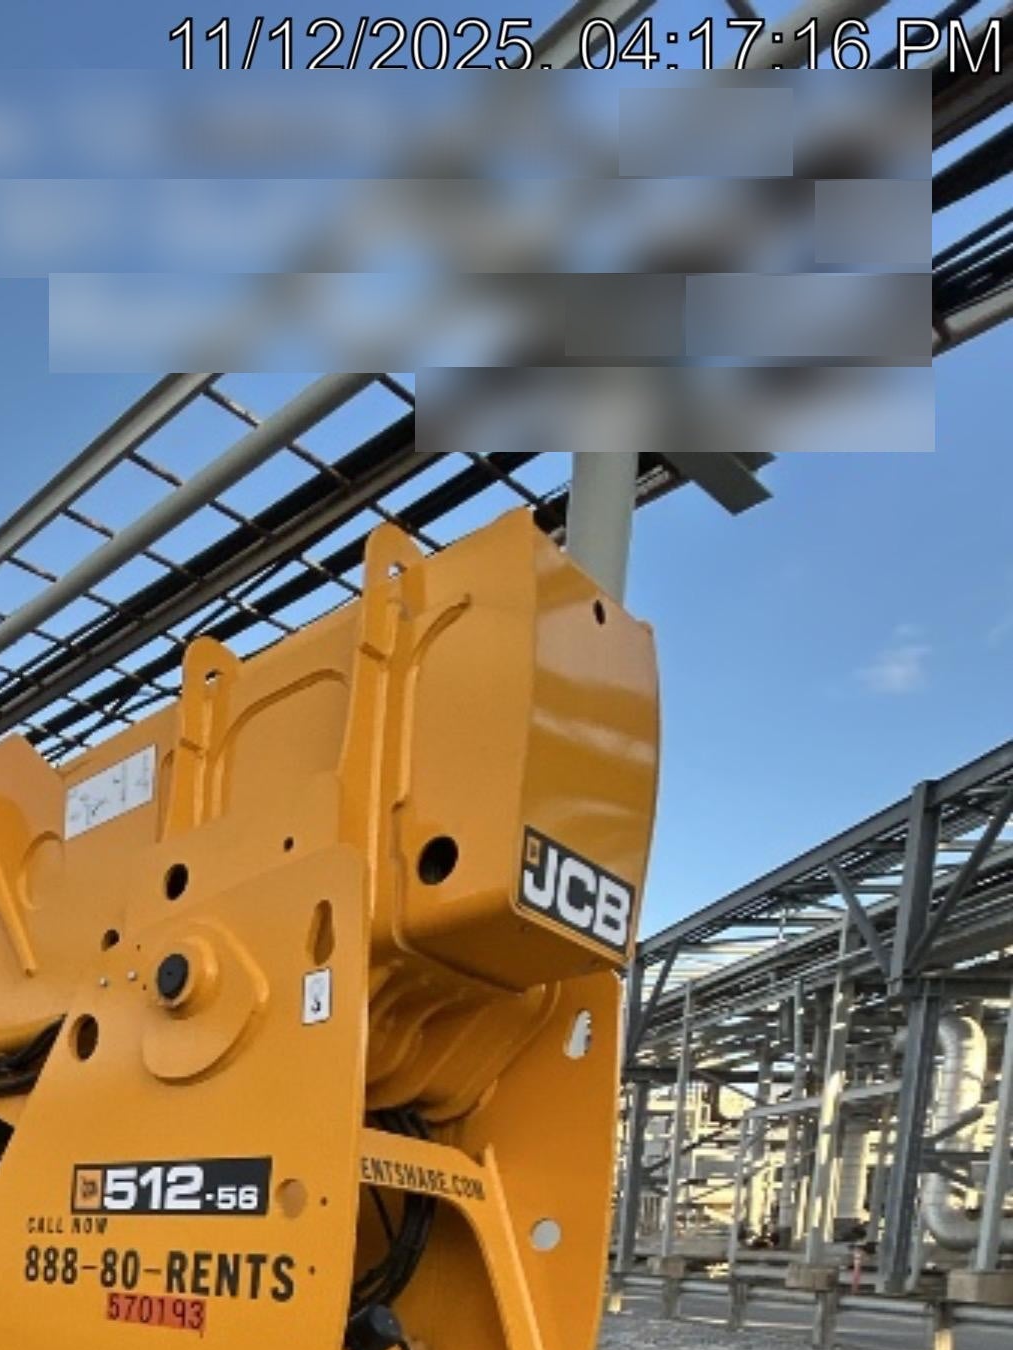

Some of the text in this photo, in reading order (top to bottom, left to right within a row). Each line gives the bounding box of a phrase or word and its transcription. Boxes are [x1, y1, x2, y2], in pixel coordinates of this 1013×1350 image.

[523, 846, 631, 946] JCB
[360, 1156, 486, 1201] ENTSHARE.COM
[27, 1216, 108, 1235] CALL NOW
[24, 1244, 296, 1302] 888-80-RENTS
[106, 1293, 205, 1331] 570193
